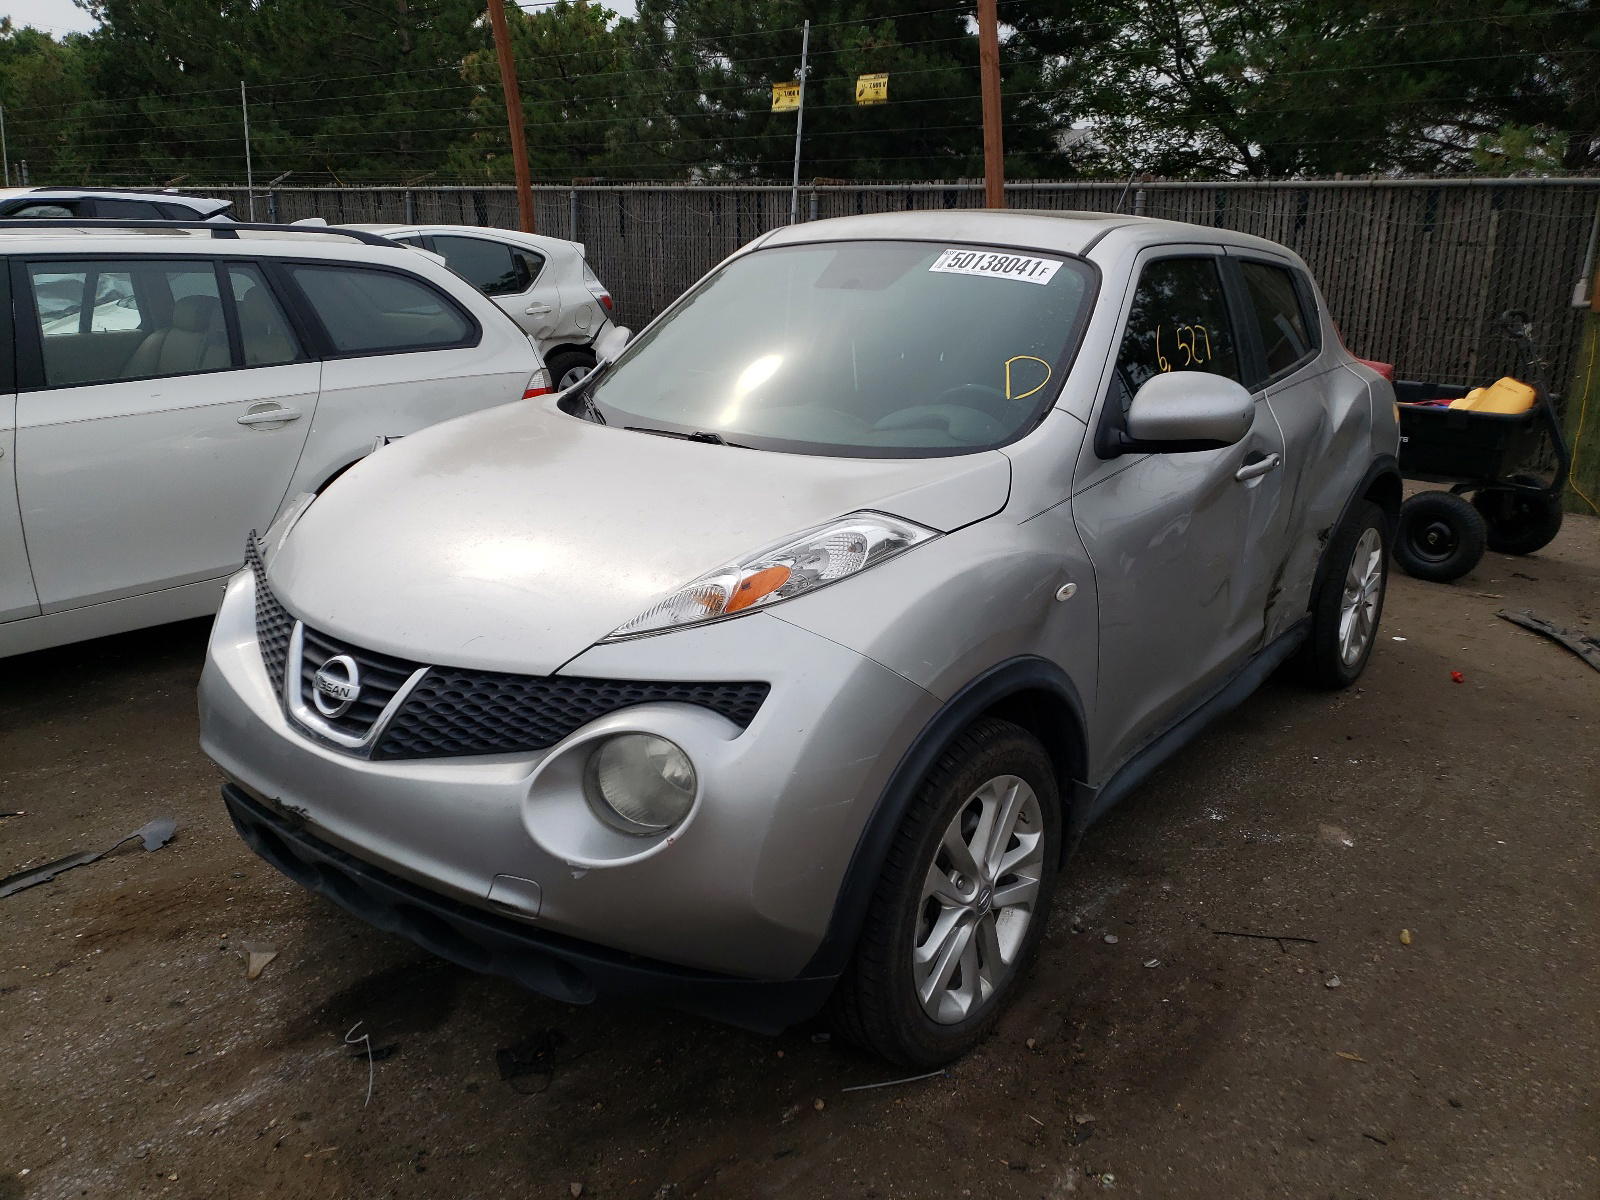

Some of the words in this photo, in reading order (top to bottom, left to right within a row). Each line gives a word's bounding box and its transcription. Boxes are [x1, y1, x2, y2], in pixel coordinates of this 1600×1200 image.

[946, 252, 1043, 277] 50138041
[1038, 267, 1050, 276] F
[1004, 355, 1052, 400] D
